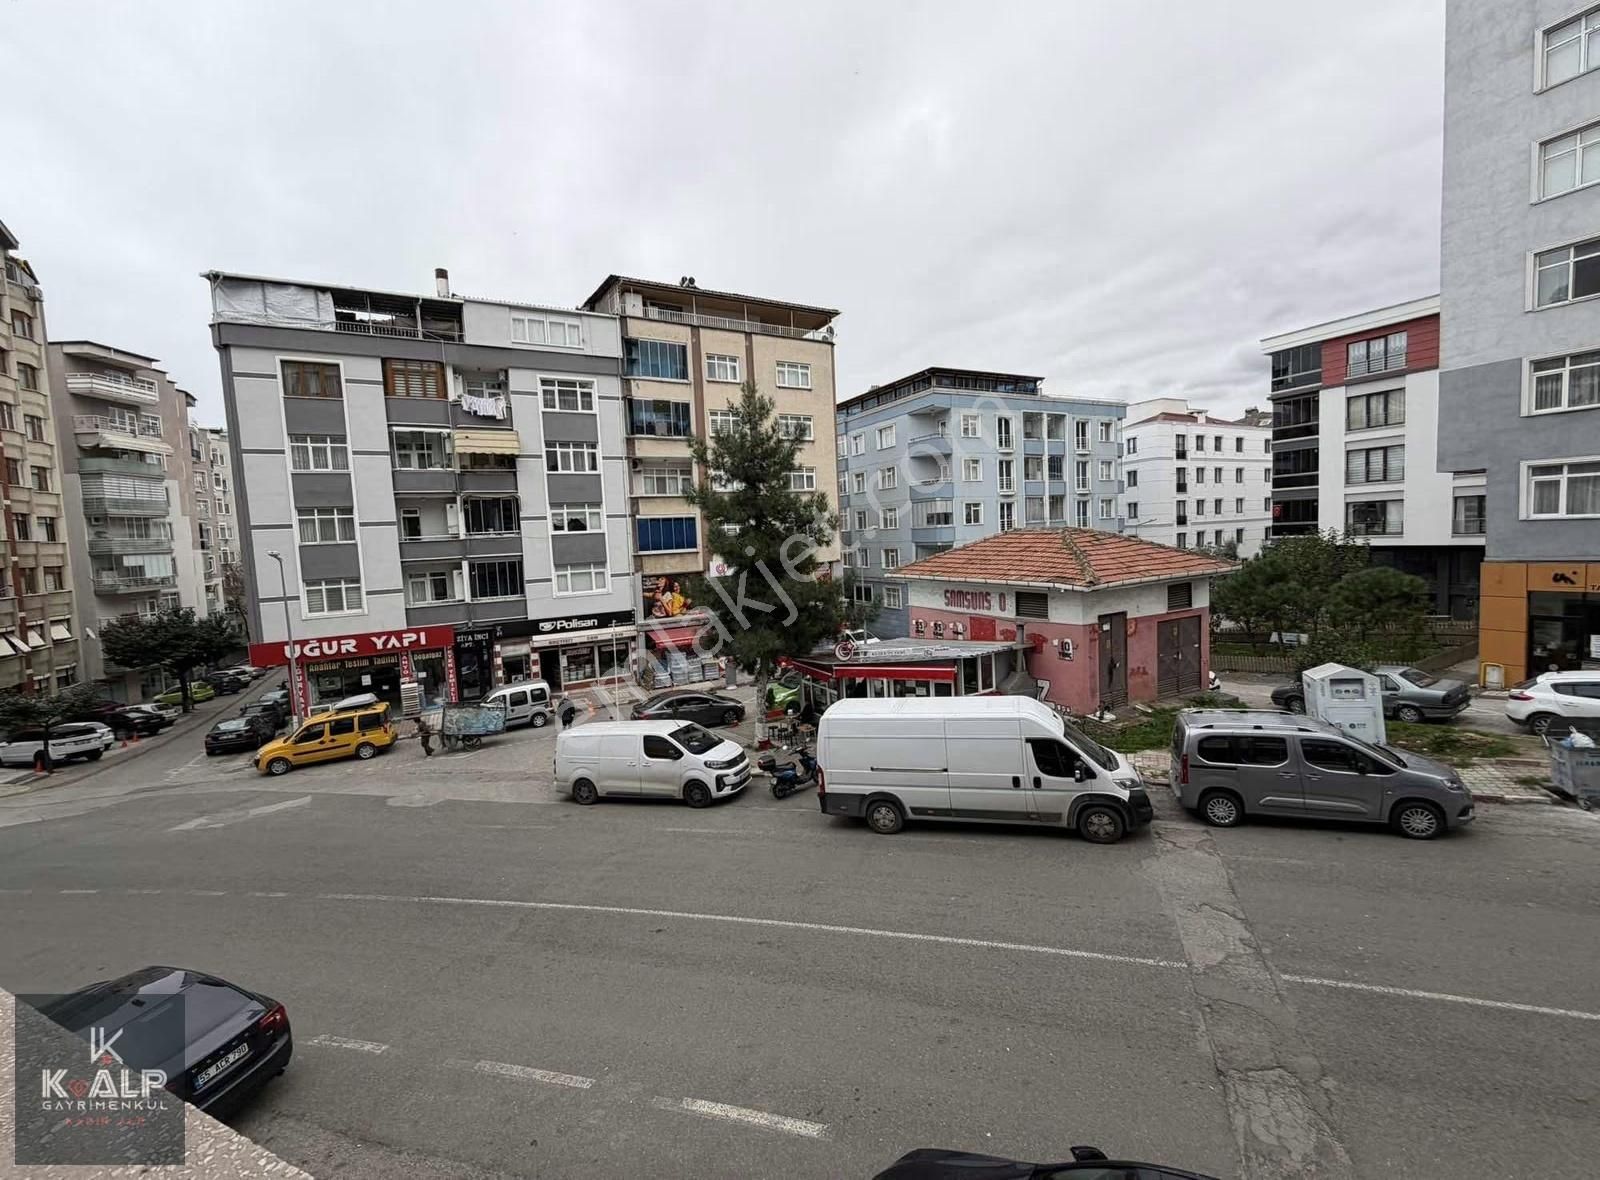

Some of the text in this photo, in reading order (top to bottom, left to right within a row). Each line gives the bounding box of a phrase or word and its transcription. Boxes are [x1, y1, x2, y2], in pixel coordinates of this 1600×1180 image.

[557, 619, 598, 629] Polisan
[284, 631, 426, 660] UĞUR YAPI
[200, 1070, 211, 1083] 55
[215, 1056, 231, 1072] ACR
